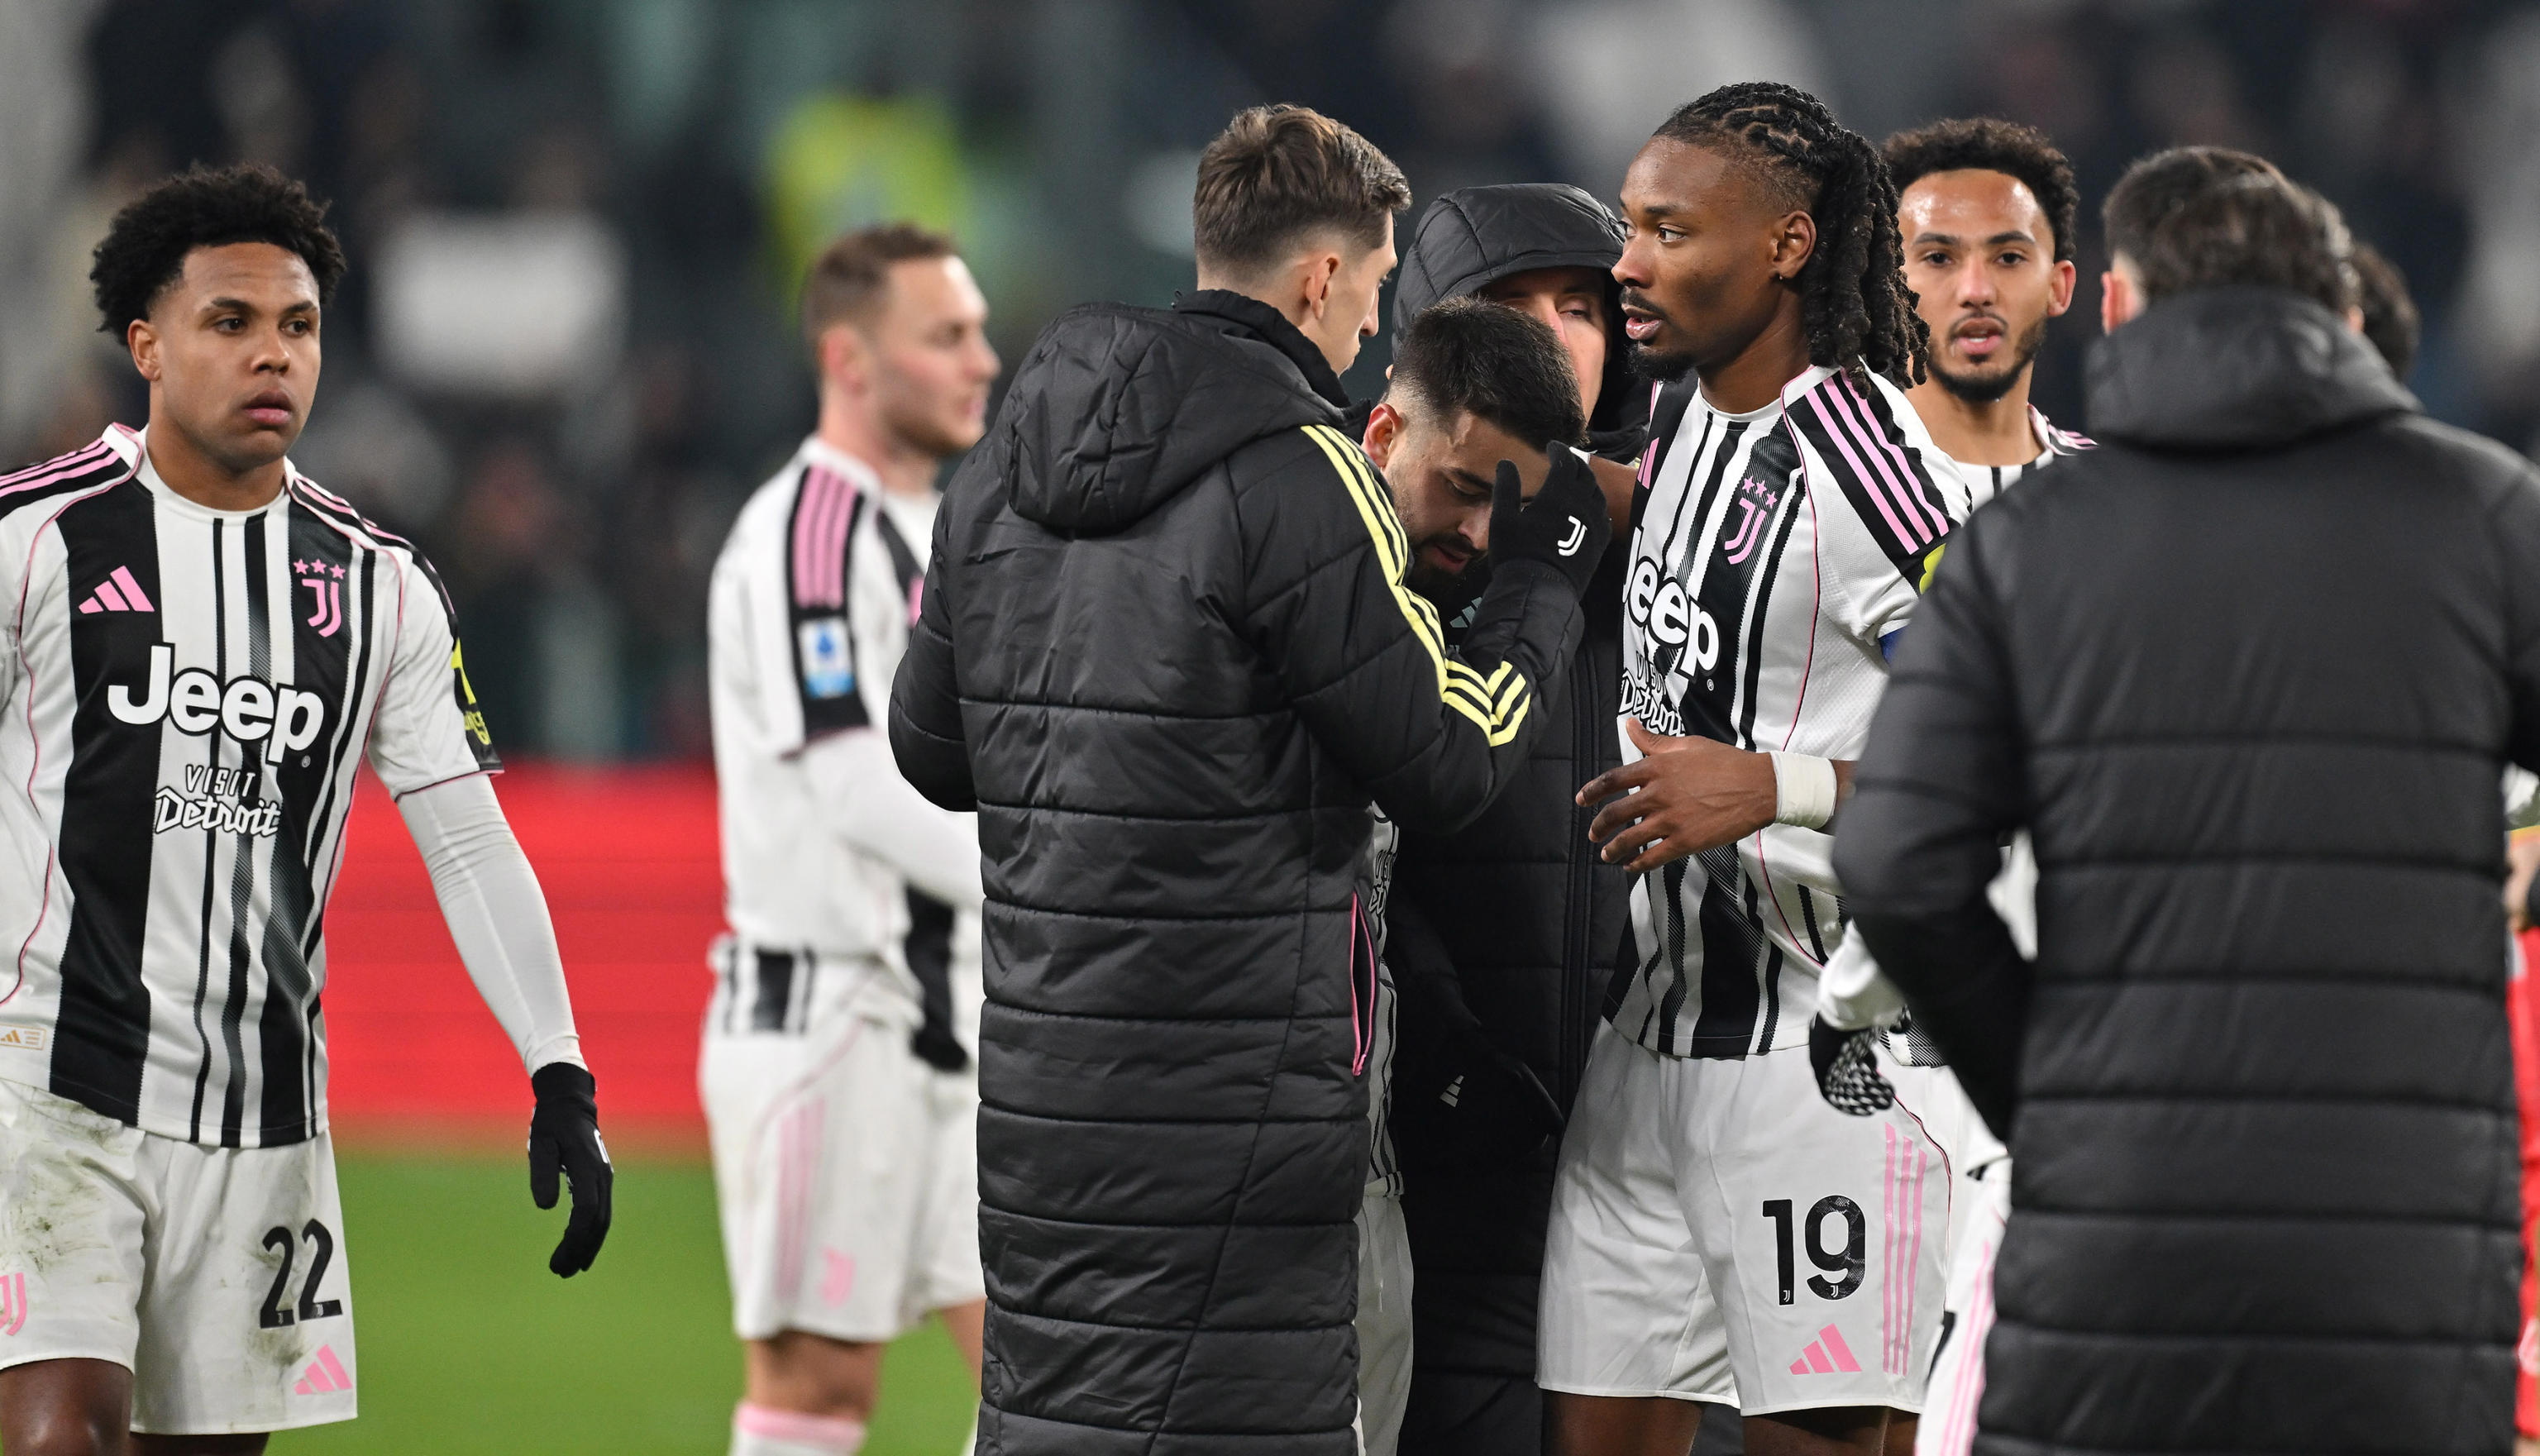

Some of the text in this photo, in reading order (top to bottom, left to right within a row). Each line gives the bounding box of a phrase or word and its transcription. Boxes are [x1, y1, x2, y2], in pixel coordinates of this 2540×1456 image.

[1622, 526, 1721, 677] Jeep
[107, 643, 325, 765] Jeep
[153, 785, 283, 838] Detroit
[184, 763, 256, 798] VISIT
[260, 1217, 343, 1329] 22
[1762, 1195, 1866, 1306] 19
